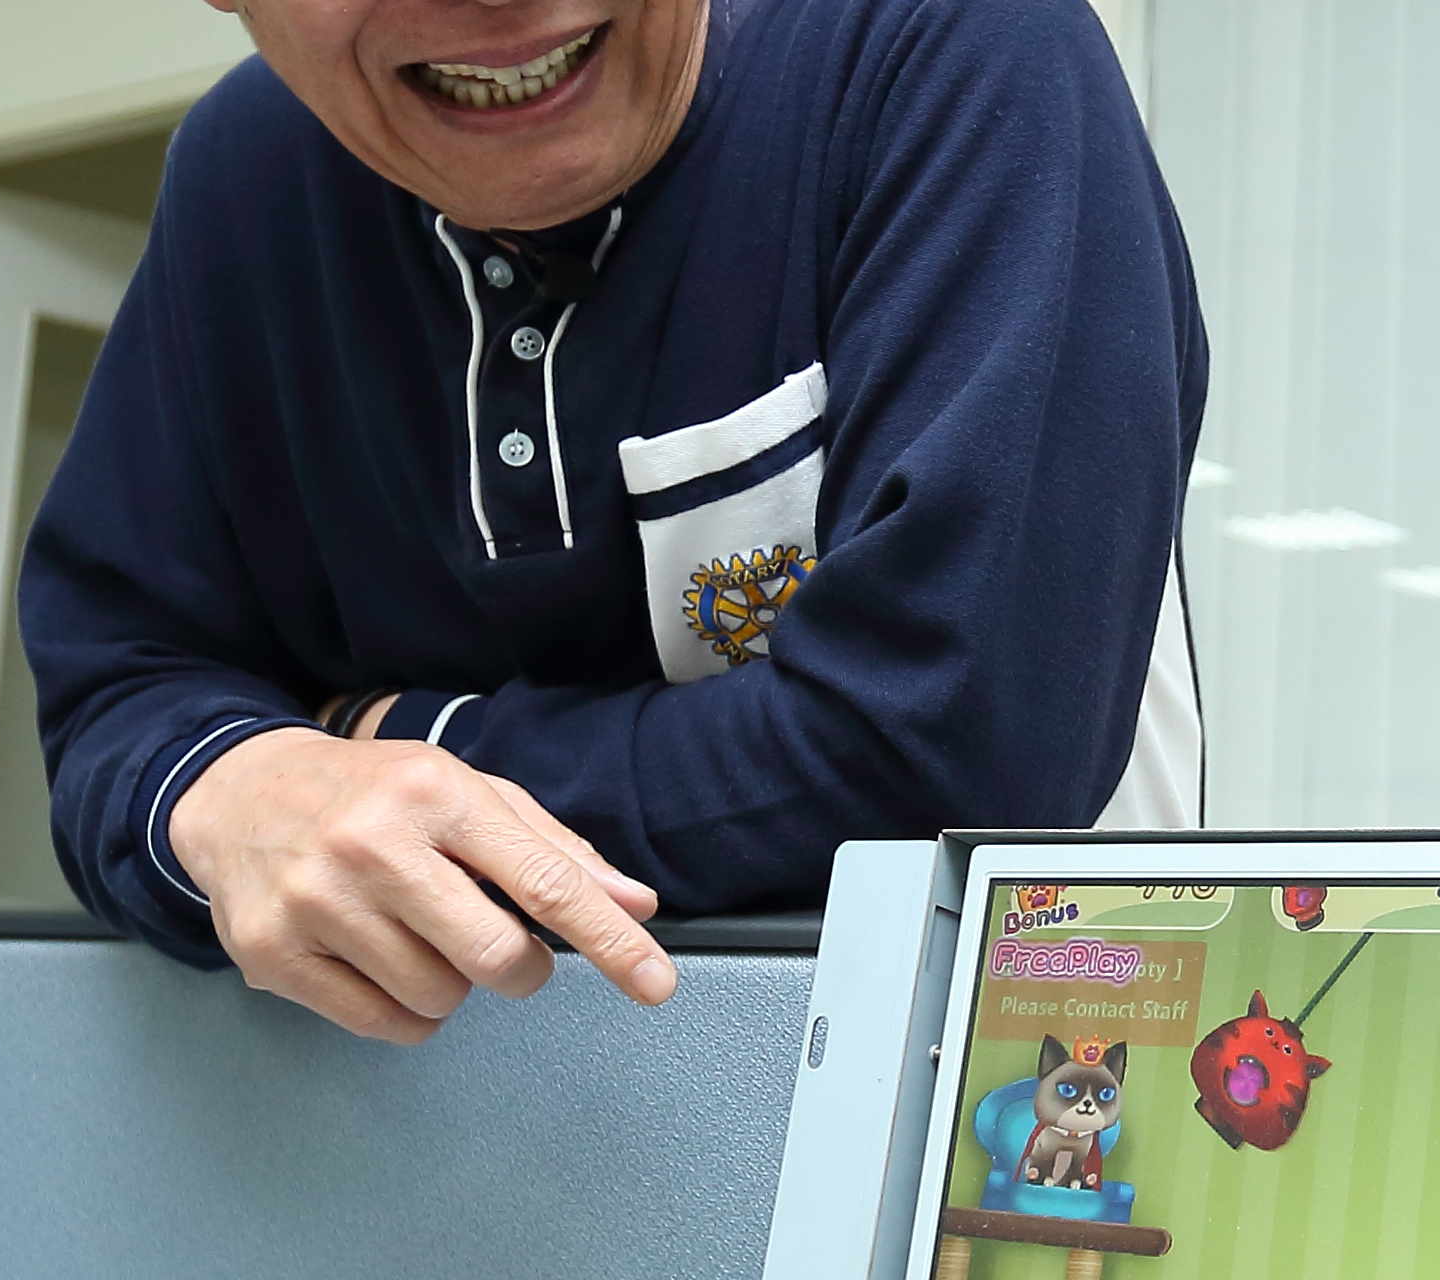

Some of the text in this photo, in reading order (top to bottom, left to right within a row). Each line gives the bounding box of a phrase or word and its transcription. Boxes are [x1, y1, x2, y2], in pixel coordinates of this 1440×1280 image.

[1003, 903, 1079, 934] Bonus
[992, 940, 1140, 985] FreePlay
[1000, 995, 1190, 1020] Please Contact Staff
